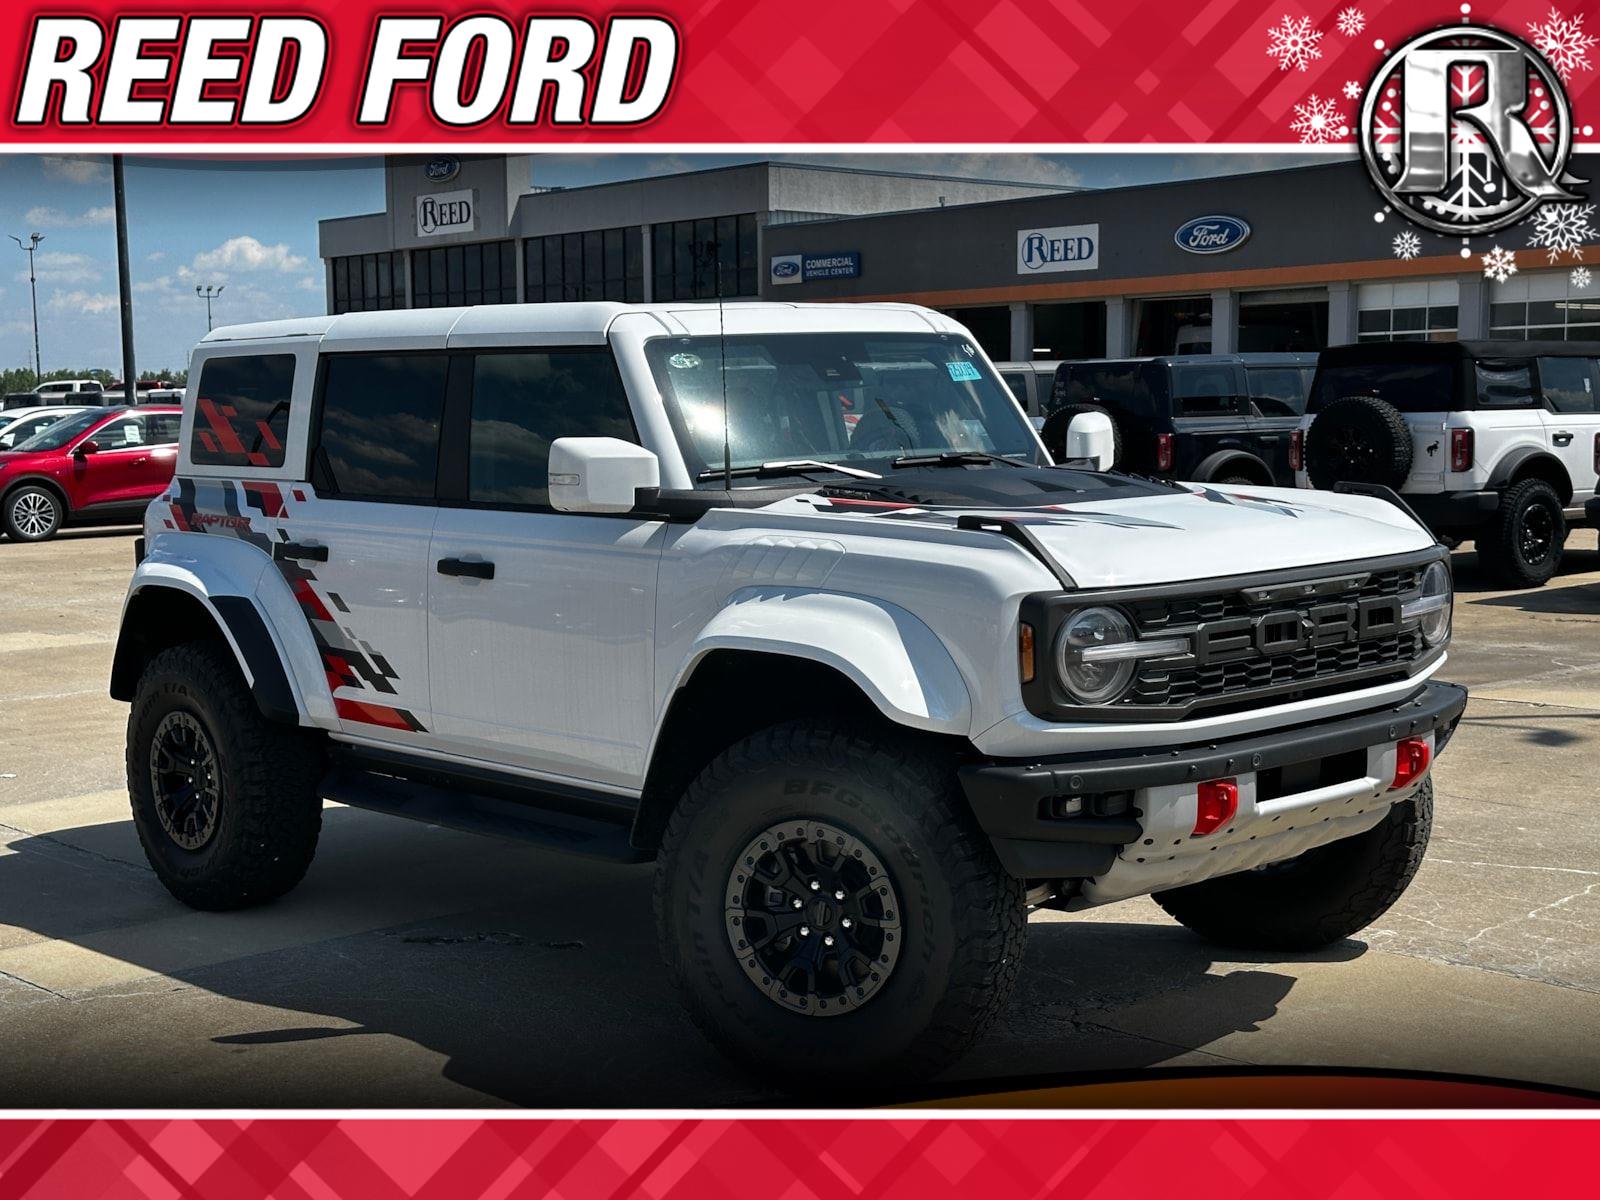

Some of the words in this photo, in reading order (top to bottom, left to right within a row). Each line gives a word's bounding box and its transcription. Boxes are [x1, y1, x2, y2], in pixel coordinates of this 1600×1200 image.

[420, 198, 471, 230] REED
[1023, 234, 1094, 266] REED
[805, 257, 854, 269] COMMERCIAL
[805, 269, 829, 277] VEHICLE
[830, 267, 854, 275] CENTER
[191, 512, 250, 530] RAPTOR
[1197, 595, 1401, 666] FORD
